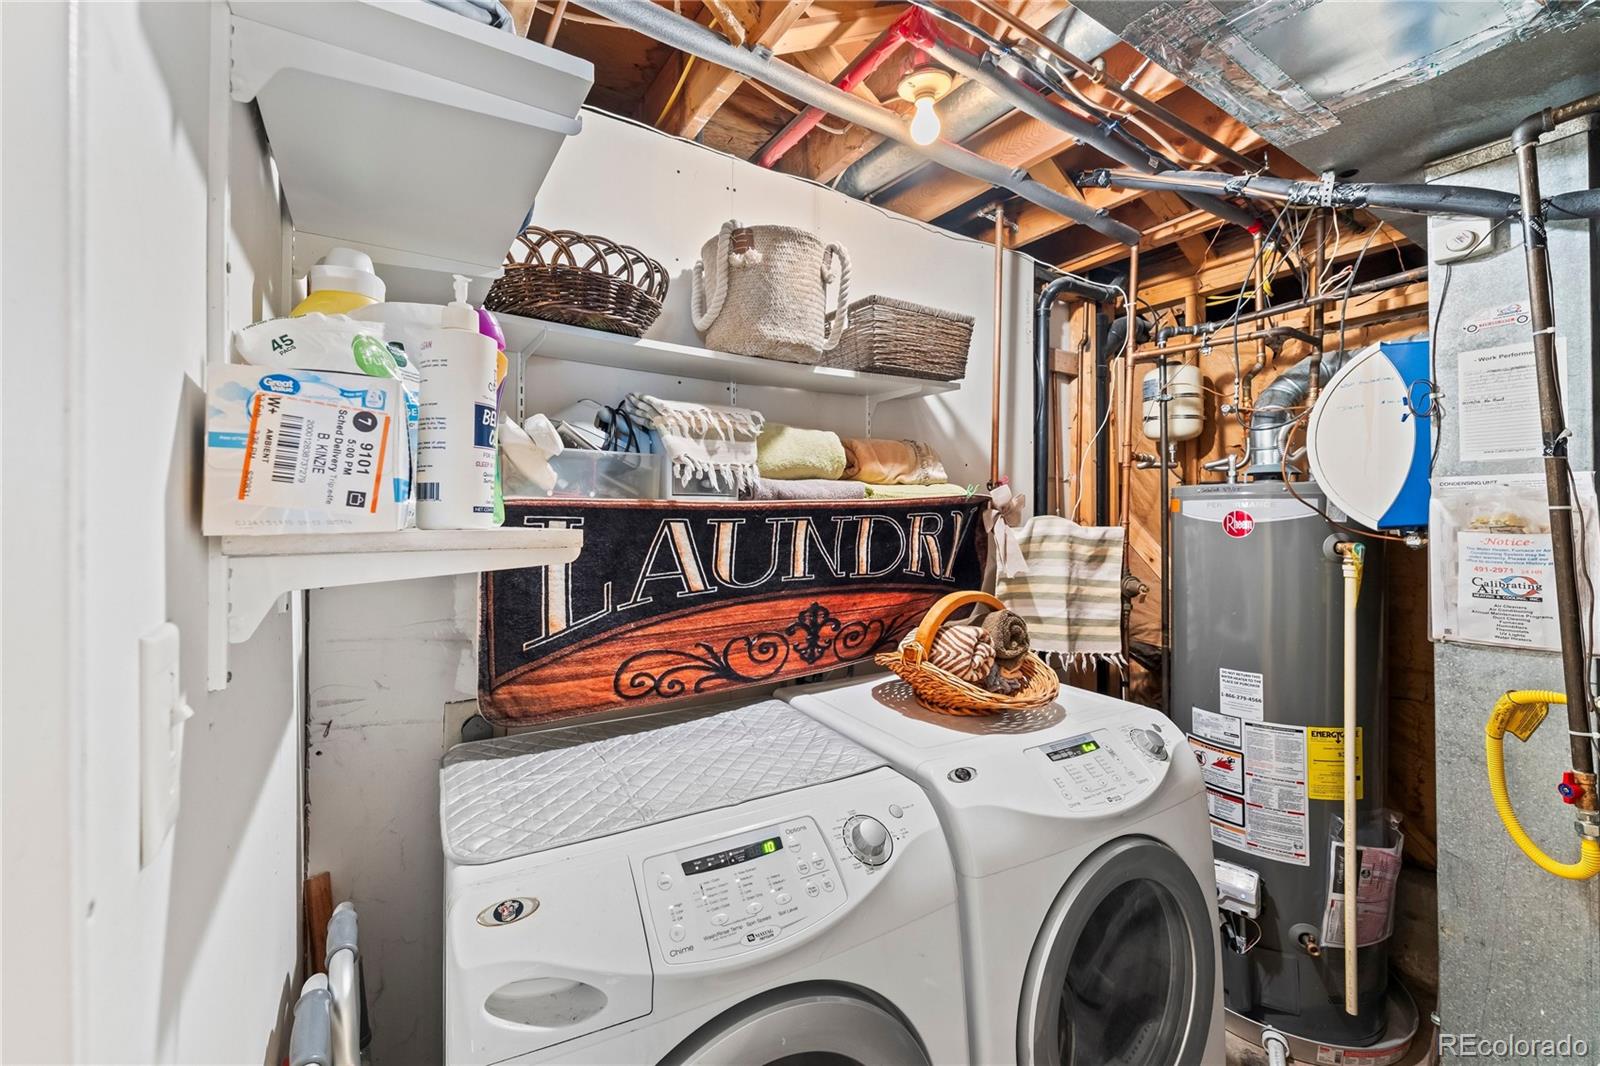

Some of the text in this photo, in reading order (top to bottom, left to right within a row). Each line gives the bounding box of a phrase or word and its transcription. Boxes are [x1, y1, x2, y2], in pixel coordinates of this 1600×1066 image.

[271, 334, 295, 352] 45
[280, 345, 297, 356] PACS
[264, 377, 293, 389] Great
[268, 397, 281, 415] W+
[336, 410, 347, 437] Sched
[357, 417, 372, 427] 7
[262, 428, 274, 464] AMBIENT
[313, 444, 329, 474] KINZIE
[327, 438, 344, 473] Delivery
[343, 439, 357, 475] 5:00 PM
[356, 442, 374, 475] 9101
[1226, 514, 1252, 533] Rheem
[1473, 566, 1514, 574] 491-2971
[523, 507, 977, 651] LAUNDRY
[1472, 576, 1543, 592] Calibrating
[1477, 584, 1500, 594] Air
[785, 825, 807, 836] Options
[763, 841, 775, 853] 10
[756, 915, 772, 923] Speed
[669, 944, 694, 957] Chime
